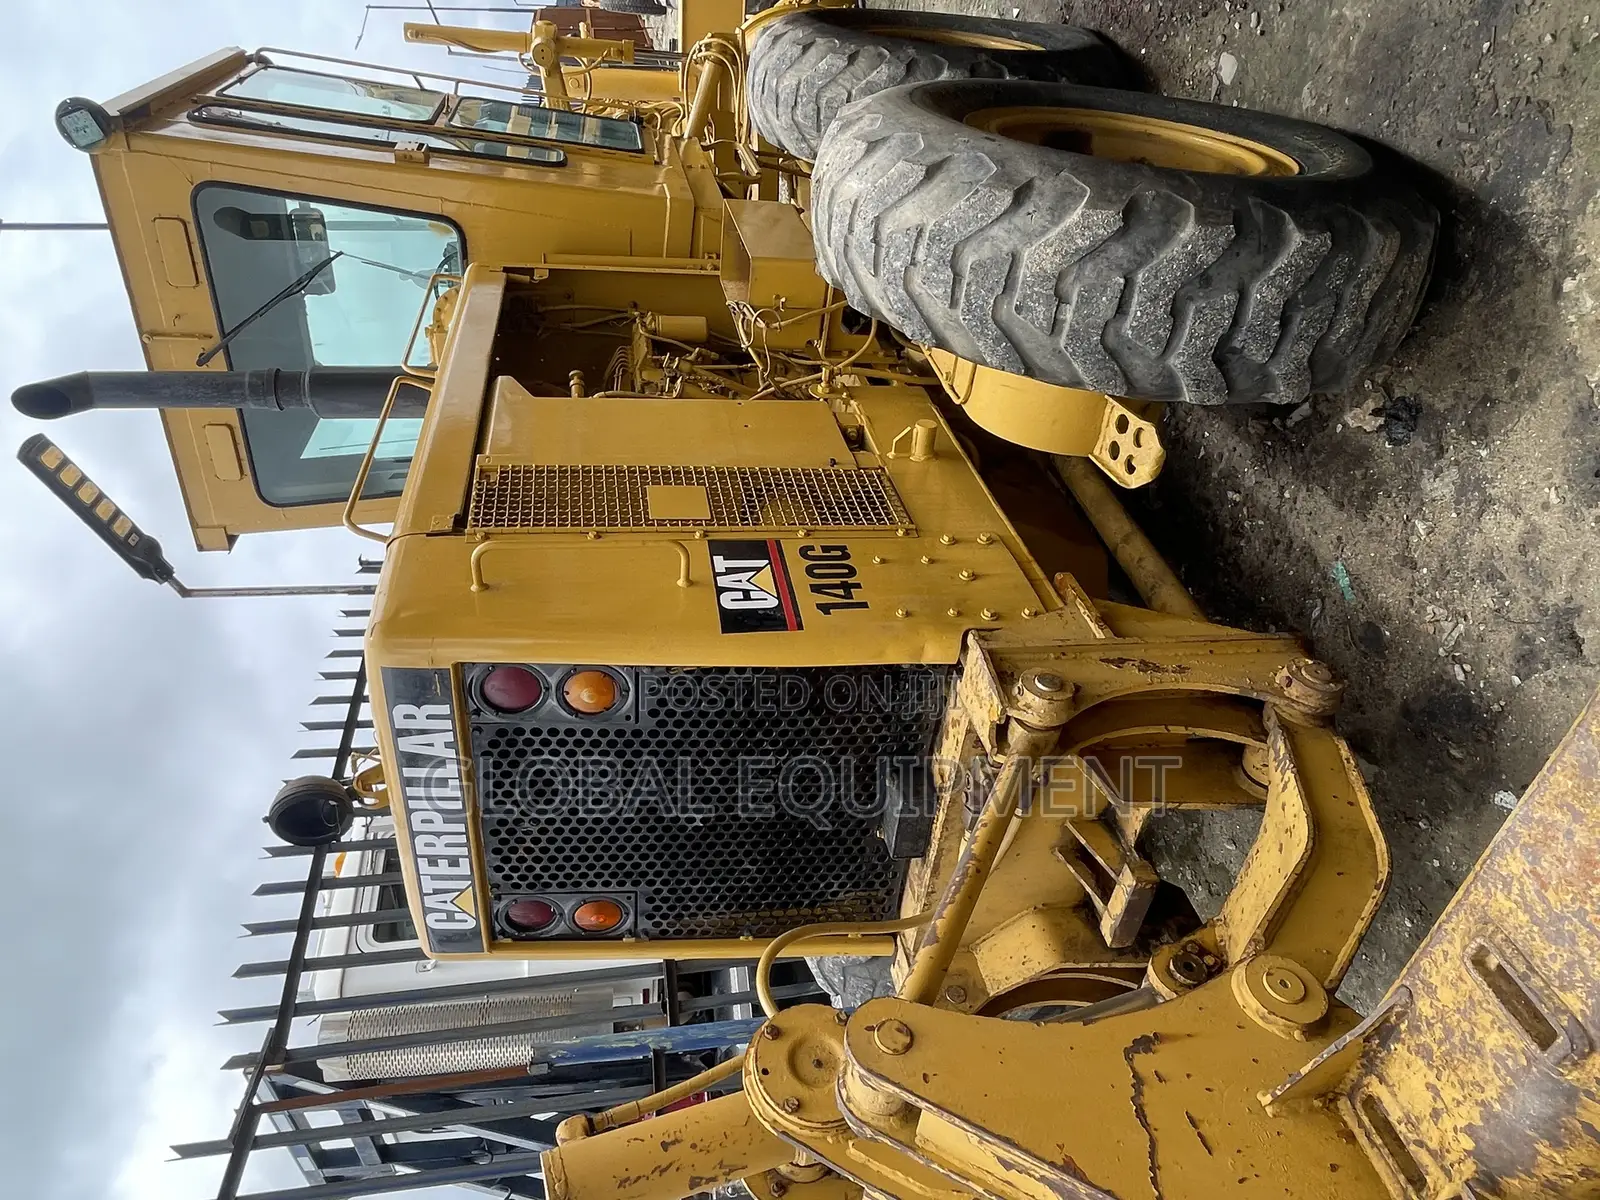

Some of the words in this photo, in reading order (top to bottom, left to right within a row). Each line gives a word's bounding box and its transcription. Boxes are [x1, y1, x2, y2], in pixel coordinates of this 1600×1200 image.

[713, 555, 779, 610] CAT
[798, 544, 870, 616] 140G
[392, 703, 477, 931] CATERPILLAR
